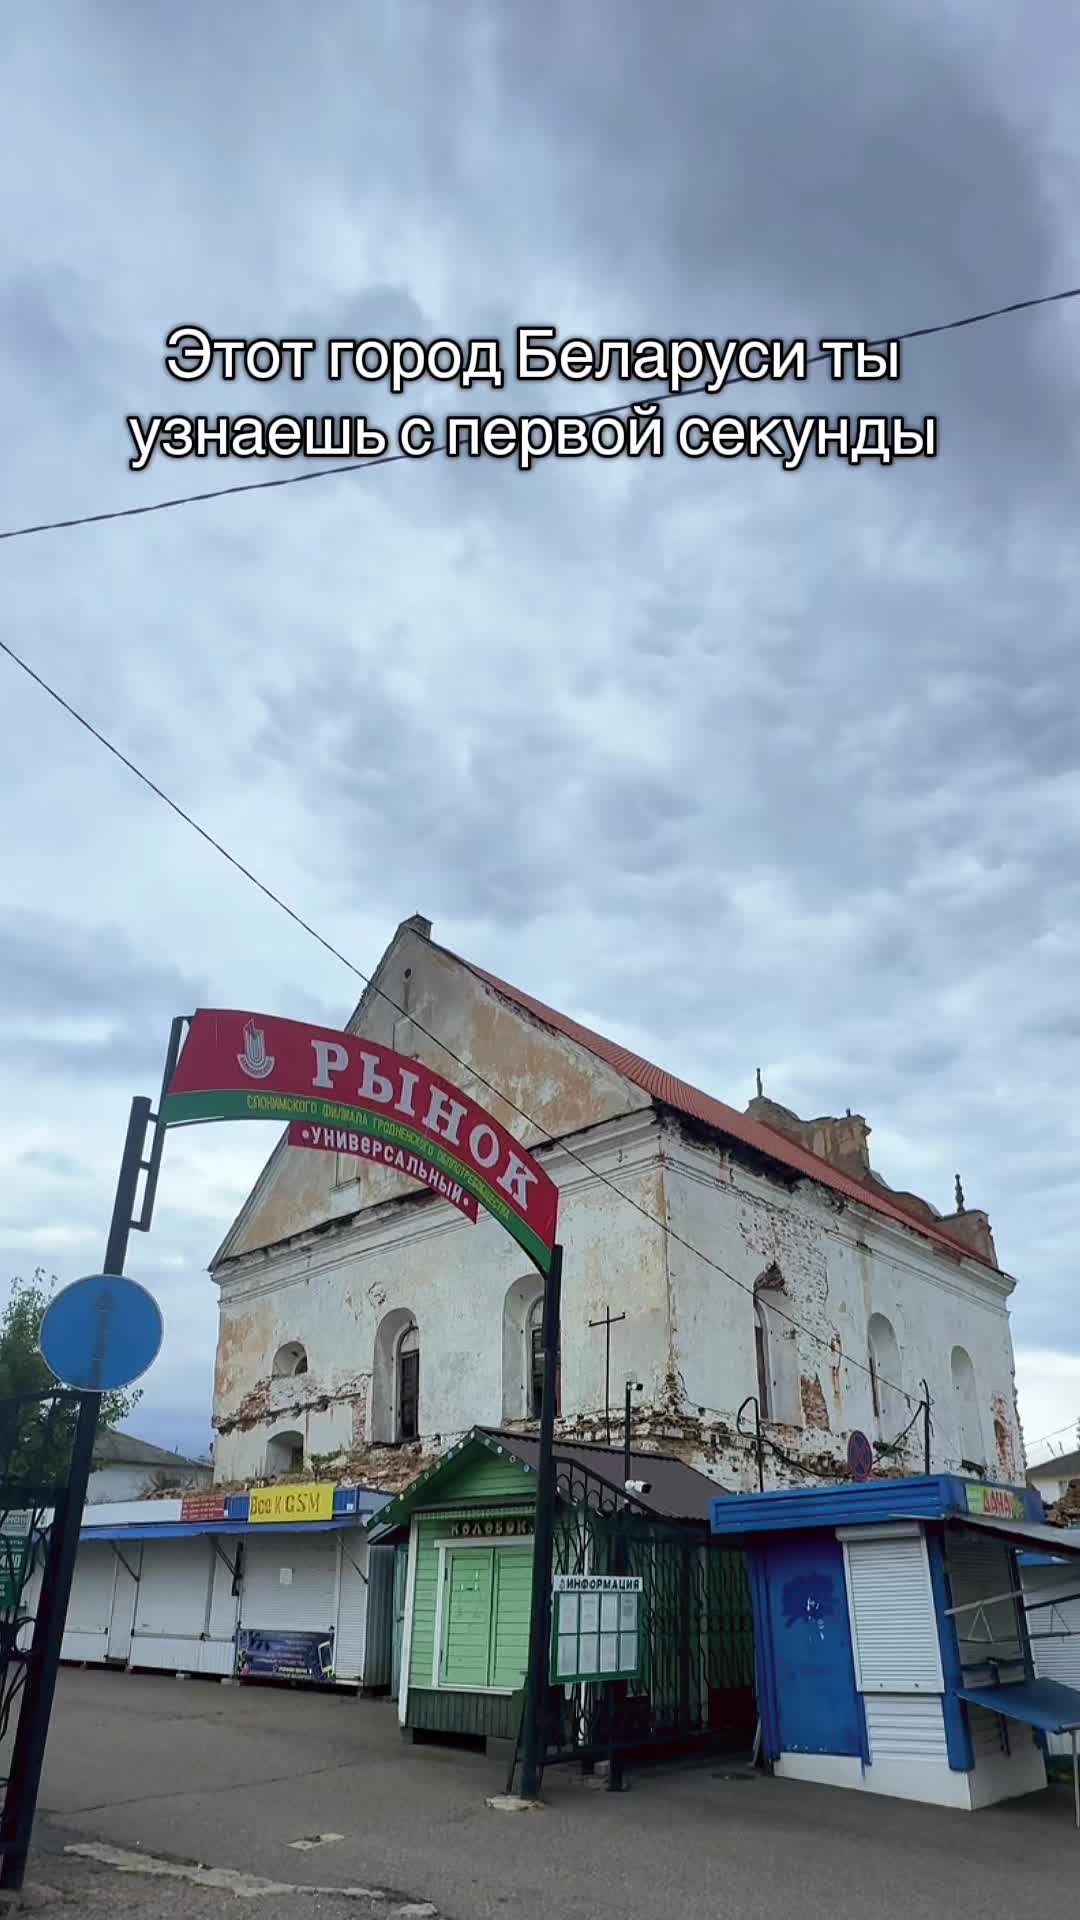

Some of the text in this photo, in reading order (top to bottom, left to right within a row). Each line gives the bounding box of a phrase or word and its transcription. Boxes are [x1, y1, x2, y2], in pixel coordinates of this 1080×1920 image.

[310, 1039, 539, 1211] РЫНОК
[285, 1492, 321, 1514] GSM
[566, 1578, 640, 1590] ИНФОРМАЦИЯ
